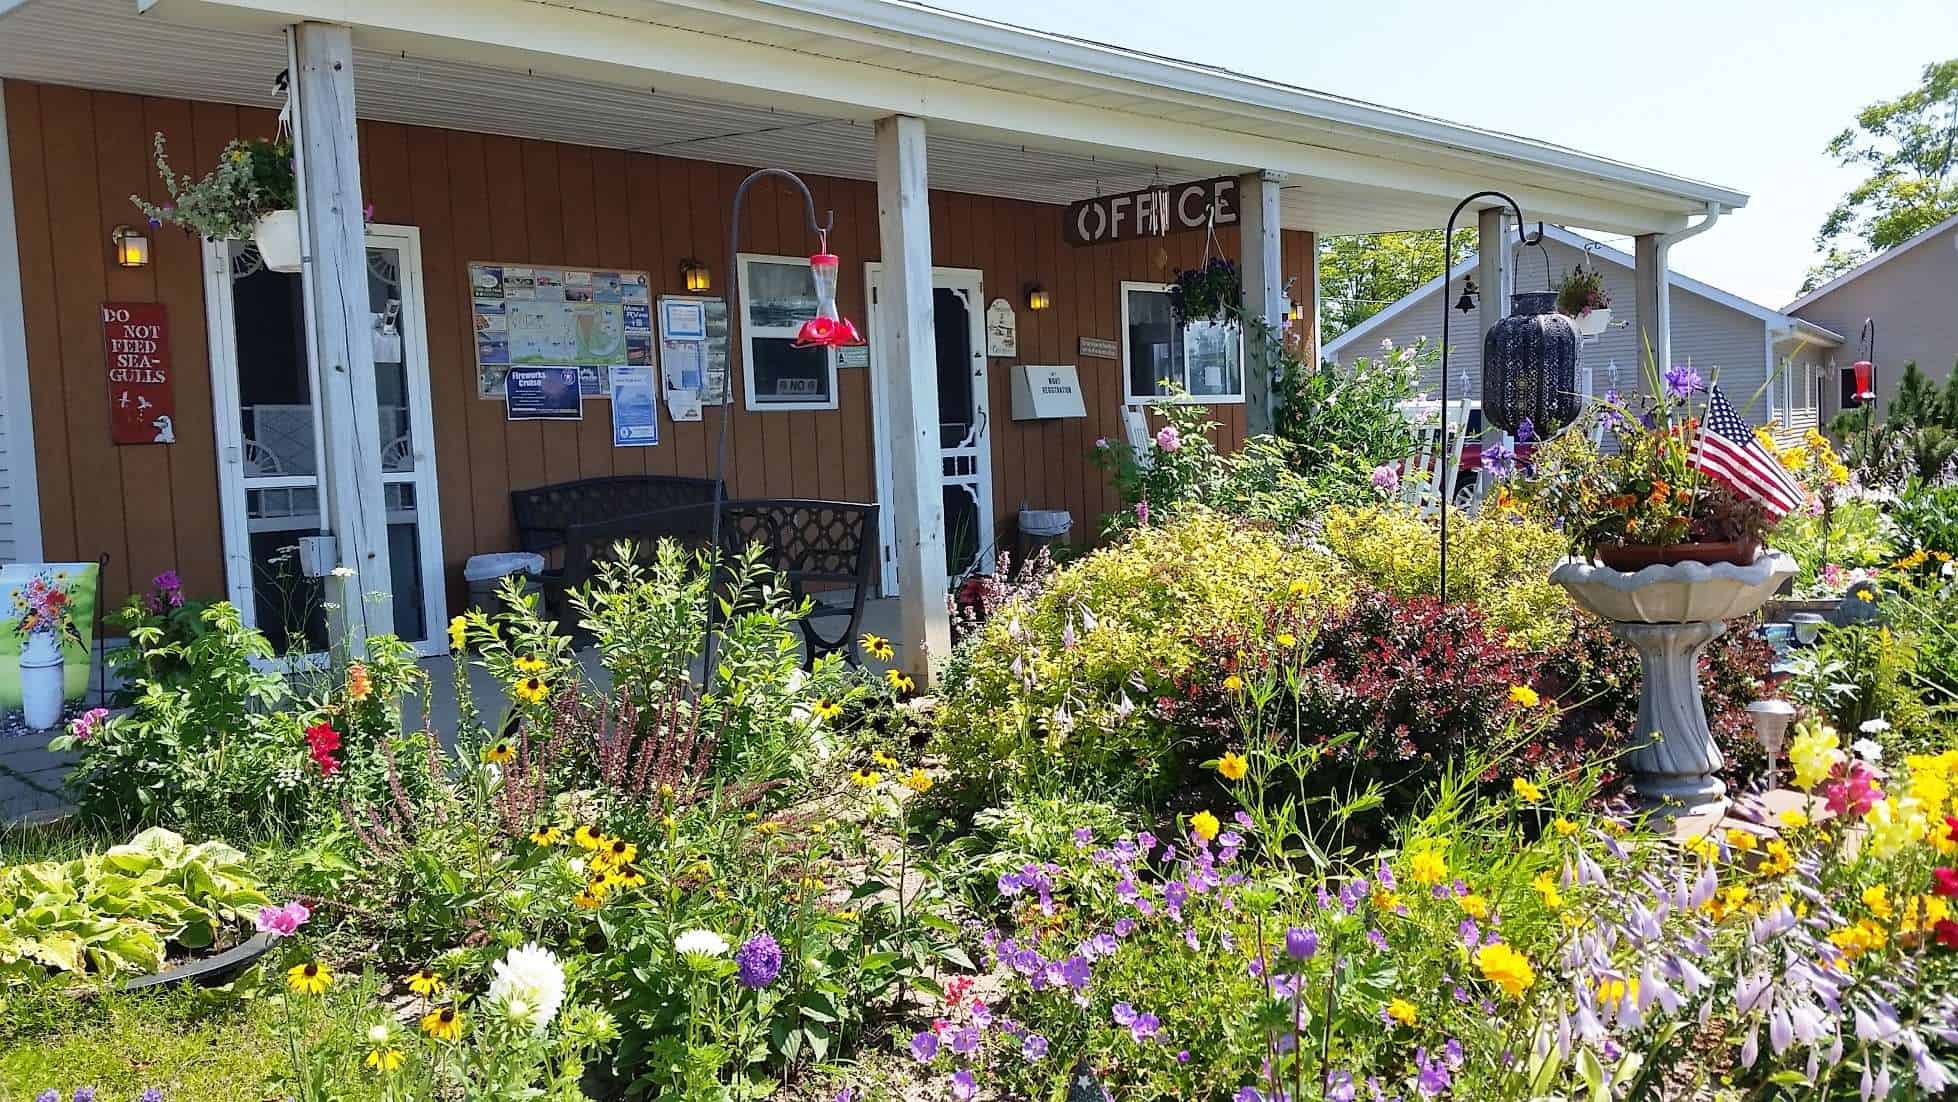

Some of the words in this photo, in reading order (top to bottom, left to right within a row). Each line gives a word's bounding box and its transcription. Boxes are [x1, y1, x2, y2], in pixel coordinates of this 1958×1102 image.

[104, 308, 130, 323] DO
[123, 325, 160, 339] NOT
[111, 339, 157, 353] FEED
[117, 354, 161, 368] SEA-
[109, 368, 166, 384] GULLS
[512, 371, 546, 380] Fireworks
[518, 379, 542, 387] Cruise
[1041, 386, 1072, 394] REGISTRATION
